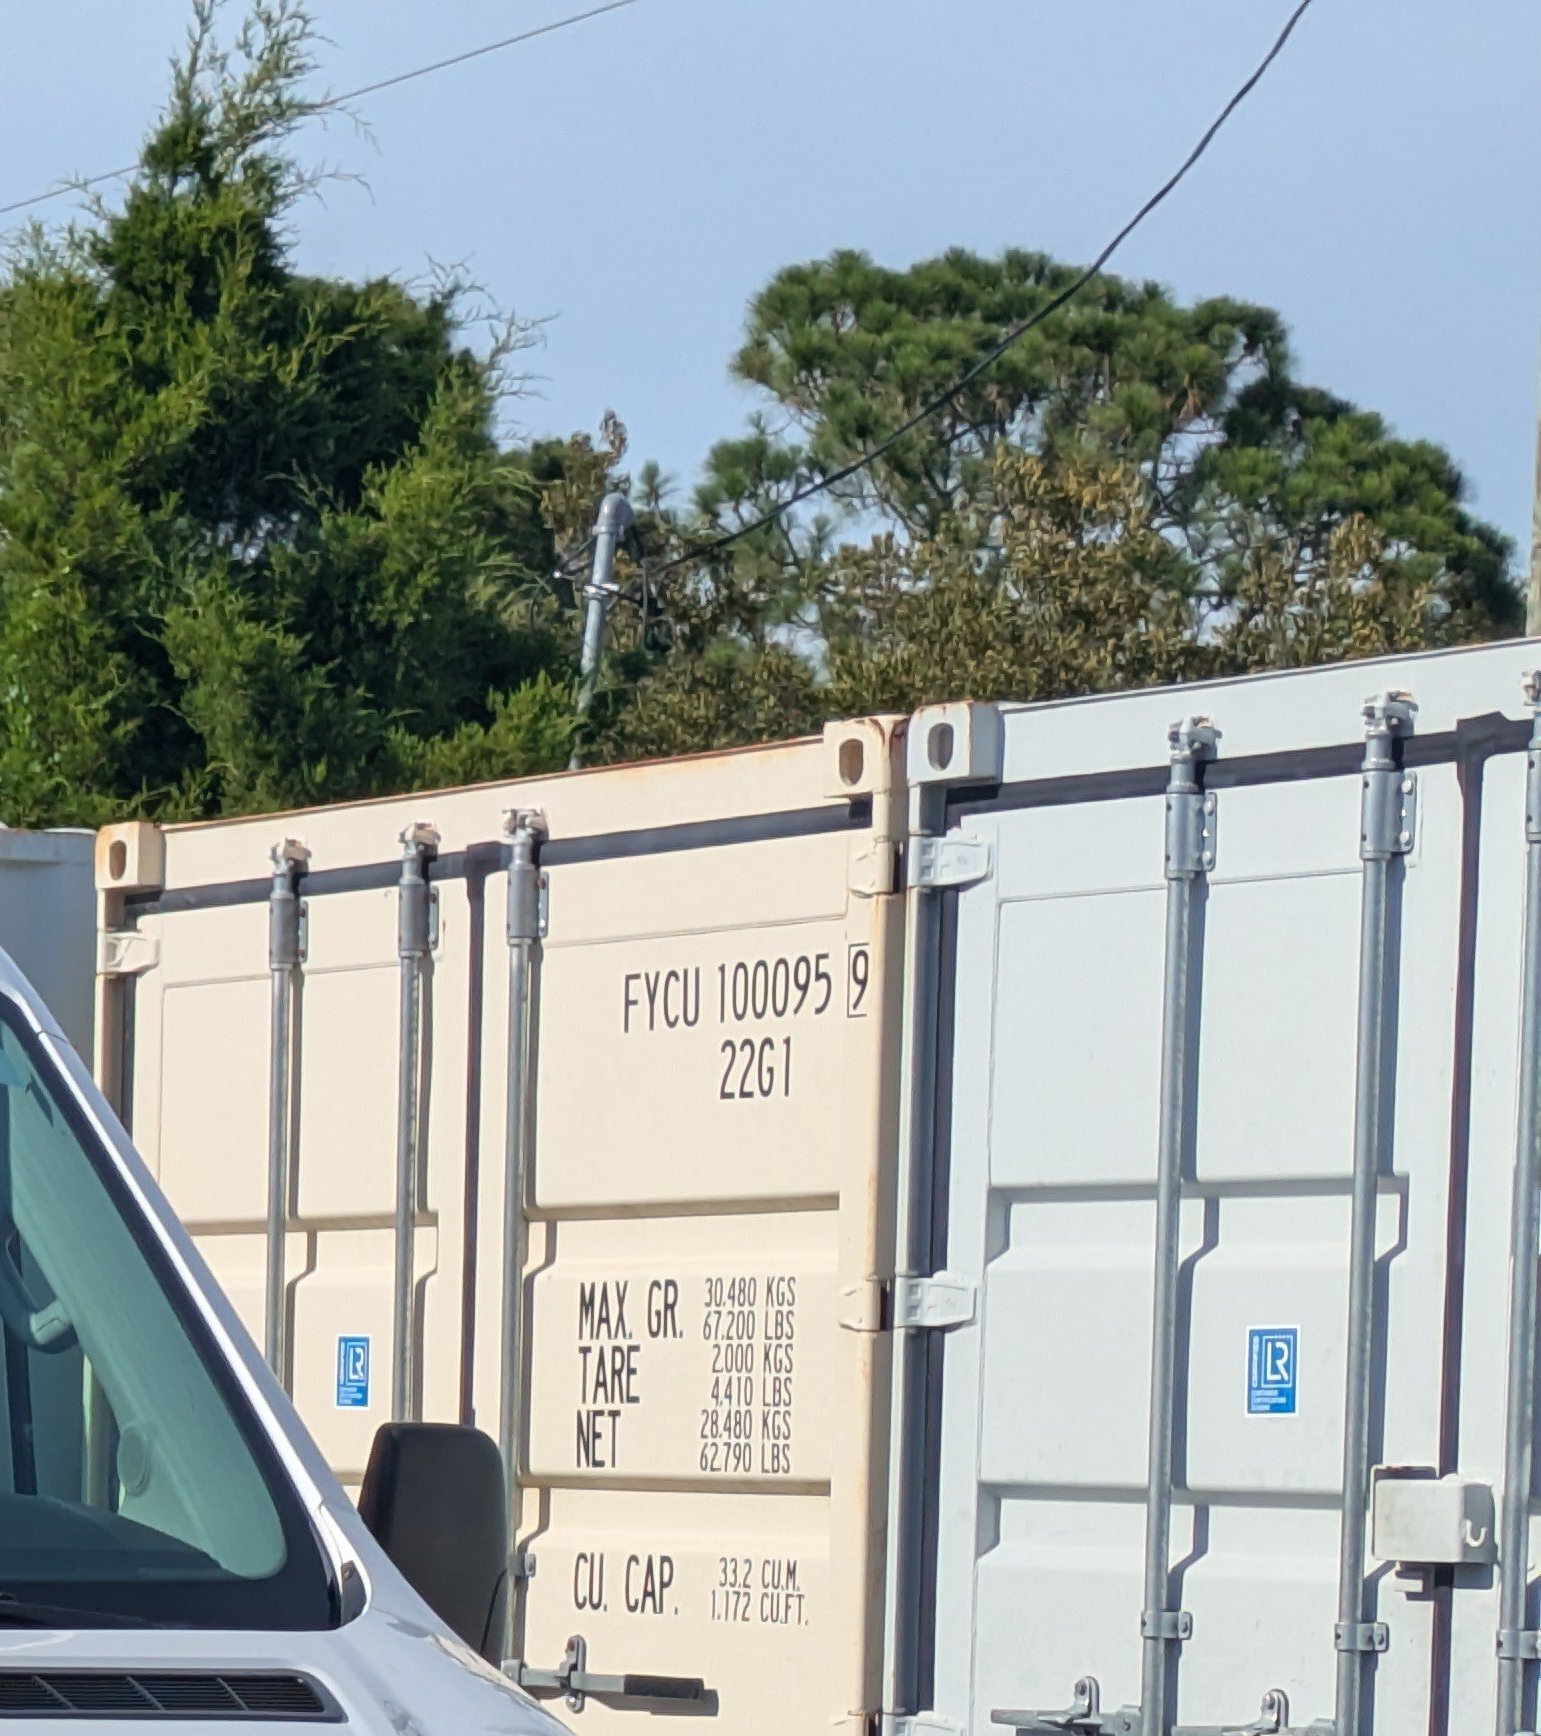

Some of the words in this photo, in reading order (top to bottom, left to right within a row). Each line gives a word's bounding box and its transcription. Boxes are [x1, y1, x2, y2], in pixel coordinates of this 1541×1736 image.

[623, 966, 700, 1034] FYCU
[718, 952, 833, 1024] 100095
[852, 949, 869, 1010] 9
[719, 1036, 791, 1100] 22G1
[704, 1276, 757, 1308] 30.480
[766, 1276, 796, 1308] KGS
[578, 1280, 633, 1341] MAX.
[647, 1278, 684, 1339] GR.
[764, 1309, 795, 1341] LBS
[578, 1344, 641, 1404] TARE
[763, 1342, 794, 1374] KGS
[1267, 1341, 1289, 1381] LR
[762, 1376, 793, 1408] LBS
[576, 1409, 621, 1469] NET
[761, 1409, 792, 1441] KGS
[761, 1442, 791, 1475] LBS
[573, 1552, 608, 1612] CU.
[624, 1553, 679, 1616] CAP.
[719, 1557, 752, 1588] 33.2
[711, 1589, 751, 1622] 1.172
